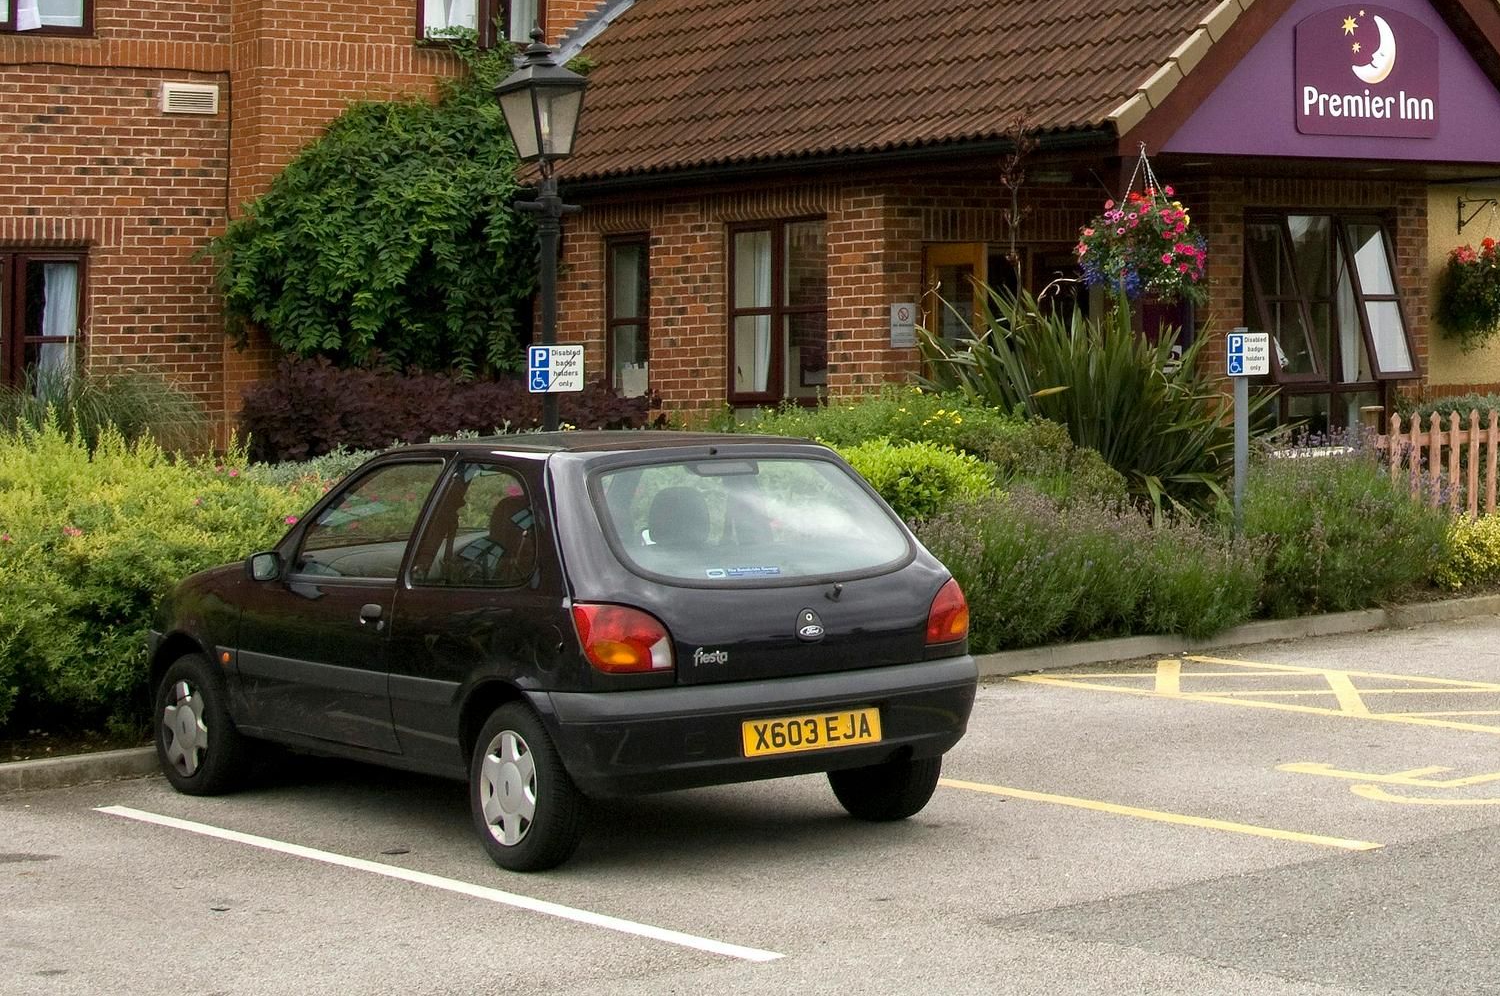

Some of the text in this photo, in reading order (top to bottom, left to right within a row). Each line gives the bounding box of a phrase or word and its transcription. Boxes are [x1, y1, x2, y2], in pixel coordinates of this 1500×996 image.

[1303, 85, 1434, 120] Premier Inn
[1232, 337, 1241, 352] P
[534, 349, 547, 367] P
[754, 713, 871, 750] X603 EJA
